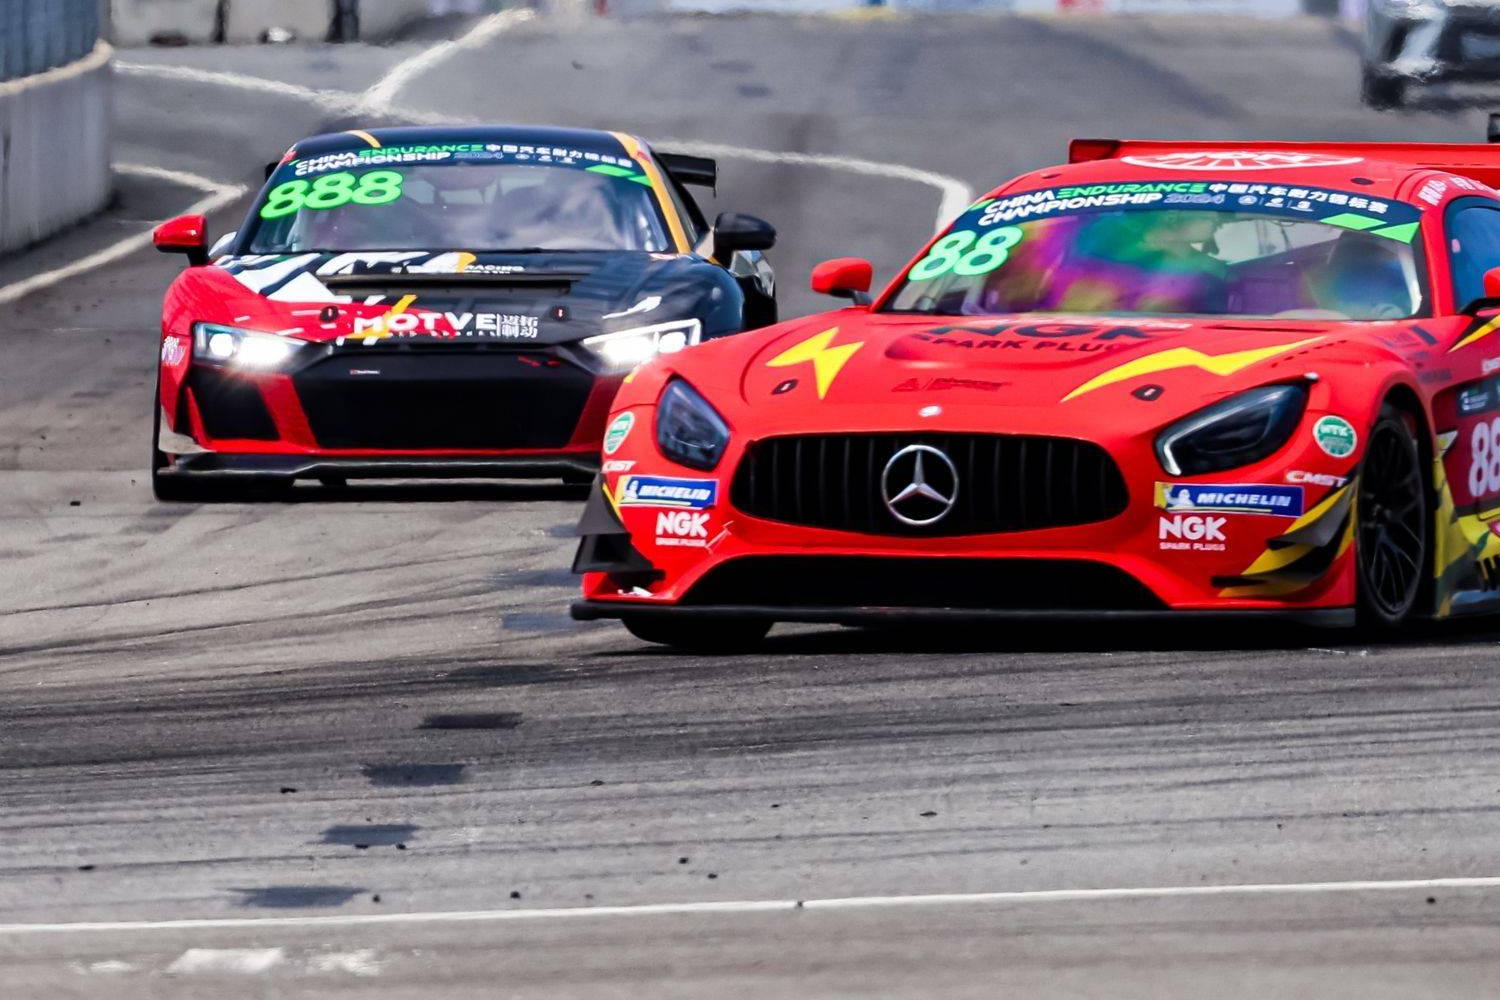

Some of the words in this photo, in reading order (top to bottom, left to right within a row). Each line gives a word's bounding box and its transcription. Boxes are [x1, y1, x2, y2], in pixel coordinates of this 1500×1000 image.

[295, 151, 452, 177] CHAMPIONSHIP
[358, 144, 485, 158] ENDURANCE
[261, 169, 404, 220] 888
[984, 190, 1056, 215] CHINA
[1056, 182, 1208, 199] ENDURANCE
[977, 192, 1163, 227] CHAMPIONSHIP
[908, 225, 1023, 282] 88
[639, 484, 712, 501] MICHELIN
[1196, 492, 1292, 507] MICHELIN
[655, 511, 711, 537] NGK
[1158, 515, 1227, 541] NGK
